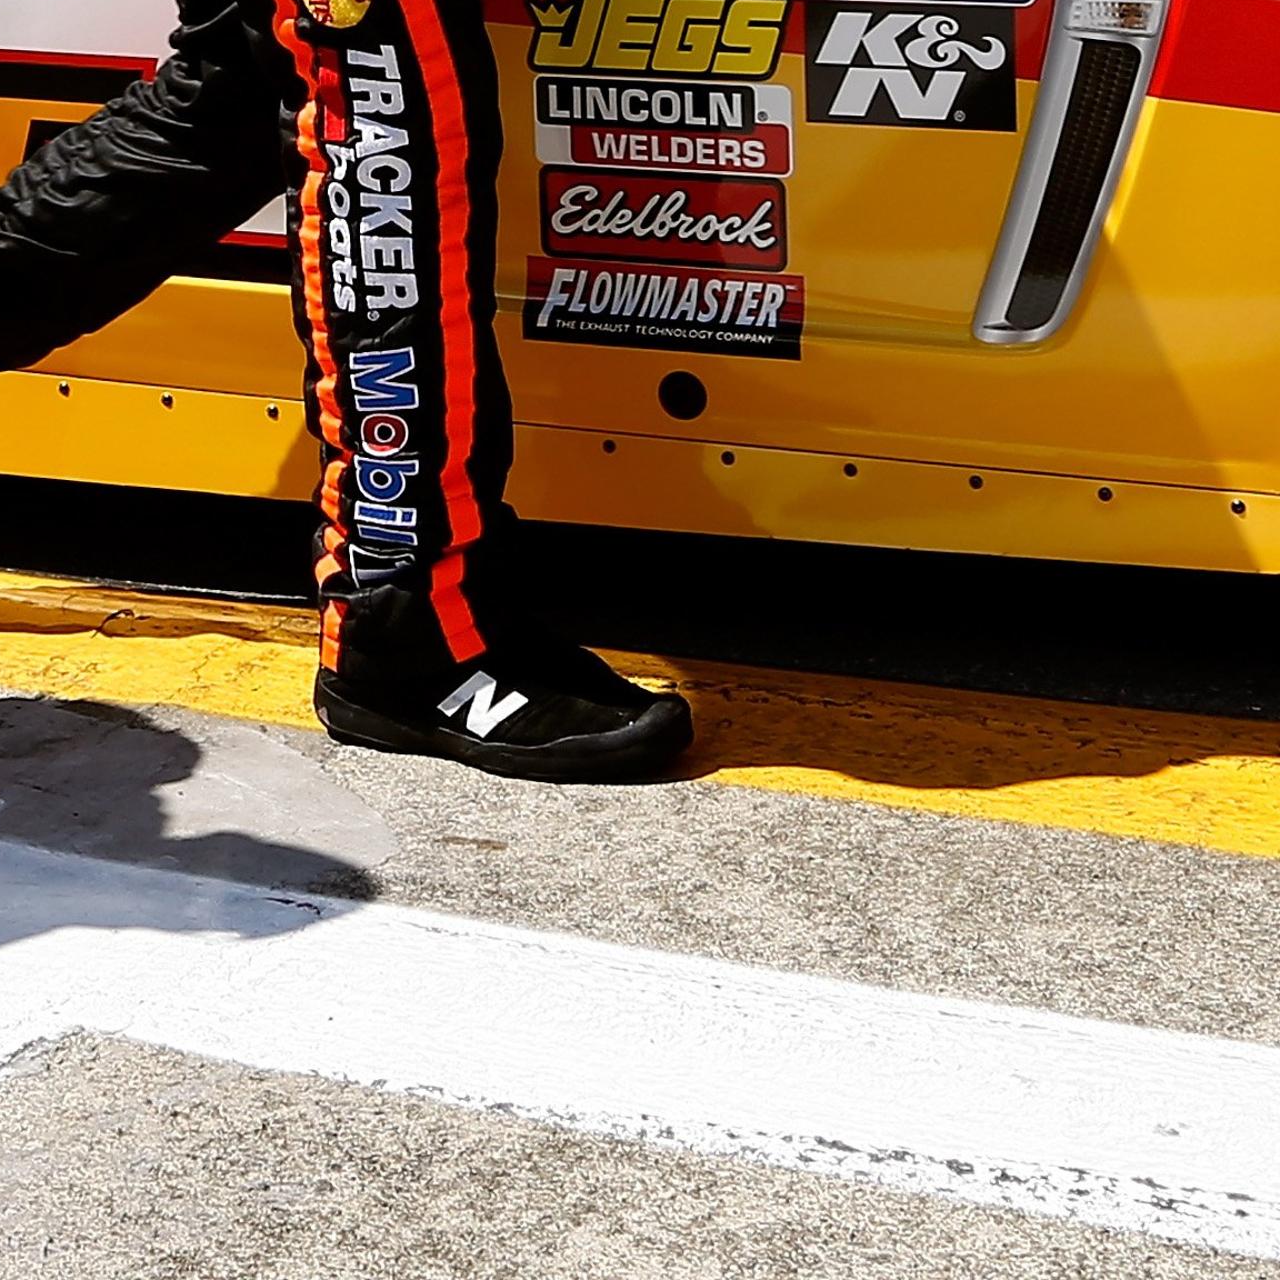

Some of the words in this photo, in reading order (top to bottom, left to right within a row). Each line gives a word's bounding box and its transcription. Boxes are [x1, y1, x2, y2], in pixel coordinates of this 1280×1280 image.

[815, 11, 1006, 71] K&
[547, 84, 744, 128] LINCOLN
[827, 67, 967, 122] N
[346, 44, 420, 311] TRACKER
[592, 132, 767, 169] WELDERS
[324, 142, 358, 314] boats
[550, 185, 777, 250] Edelbrock
[536, 267, 787, 329] FLOWMASTER
[556, 319, 576, 330] THE
[579, 321, 631, 333] EXHAUST
[635, 324, 714, 339] TECHNOLOGY
[715, 331, 775, 345] COMPANY
[349, 346, 420, 547] Mobil
[436, 670, 529, 738] N
